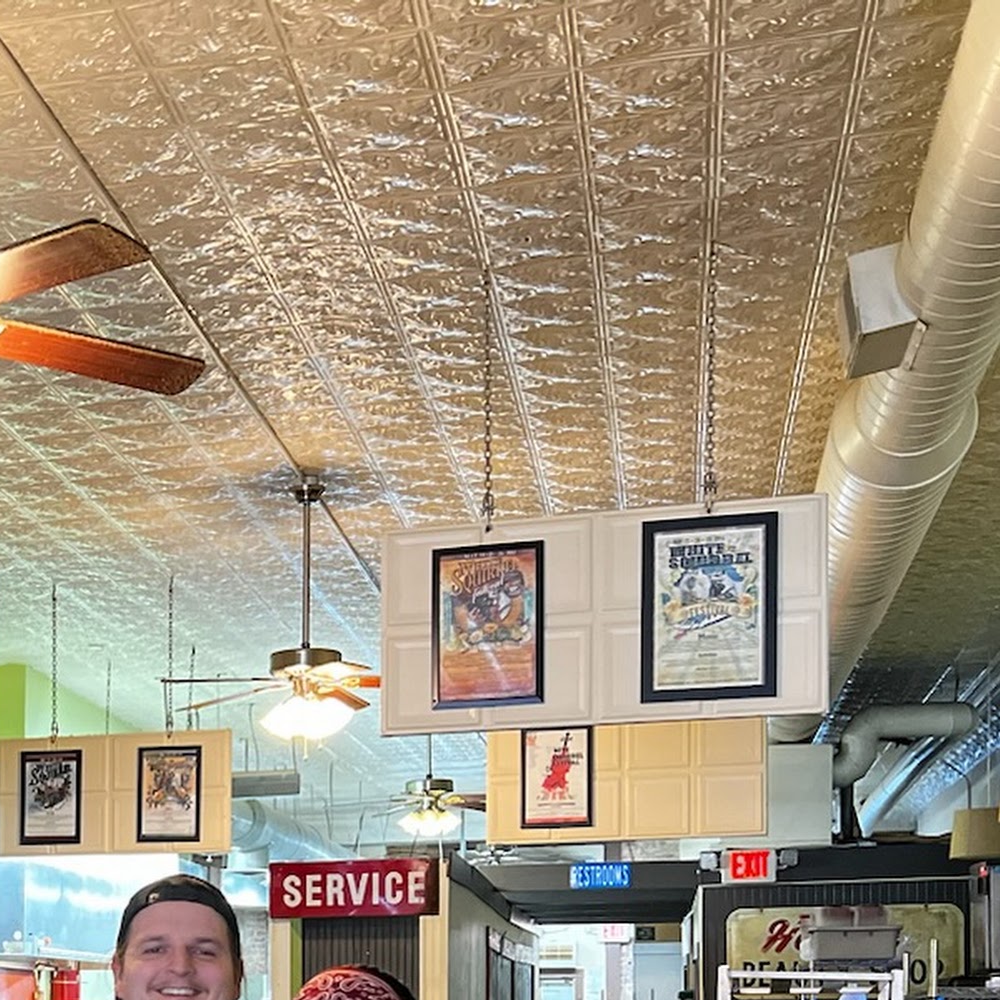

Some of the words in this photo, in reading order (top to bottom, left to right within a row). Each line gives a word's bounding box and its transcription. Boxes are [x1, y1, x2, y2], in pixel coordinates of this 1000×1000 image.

[669, 543, 725, 558] WHITE
[570, 864, 630, 888] RESTROOMS
[731, 851, 769, 879] EXIT
[282, 870, 426, 908] SERVICE
